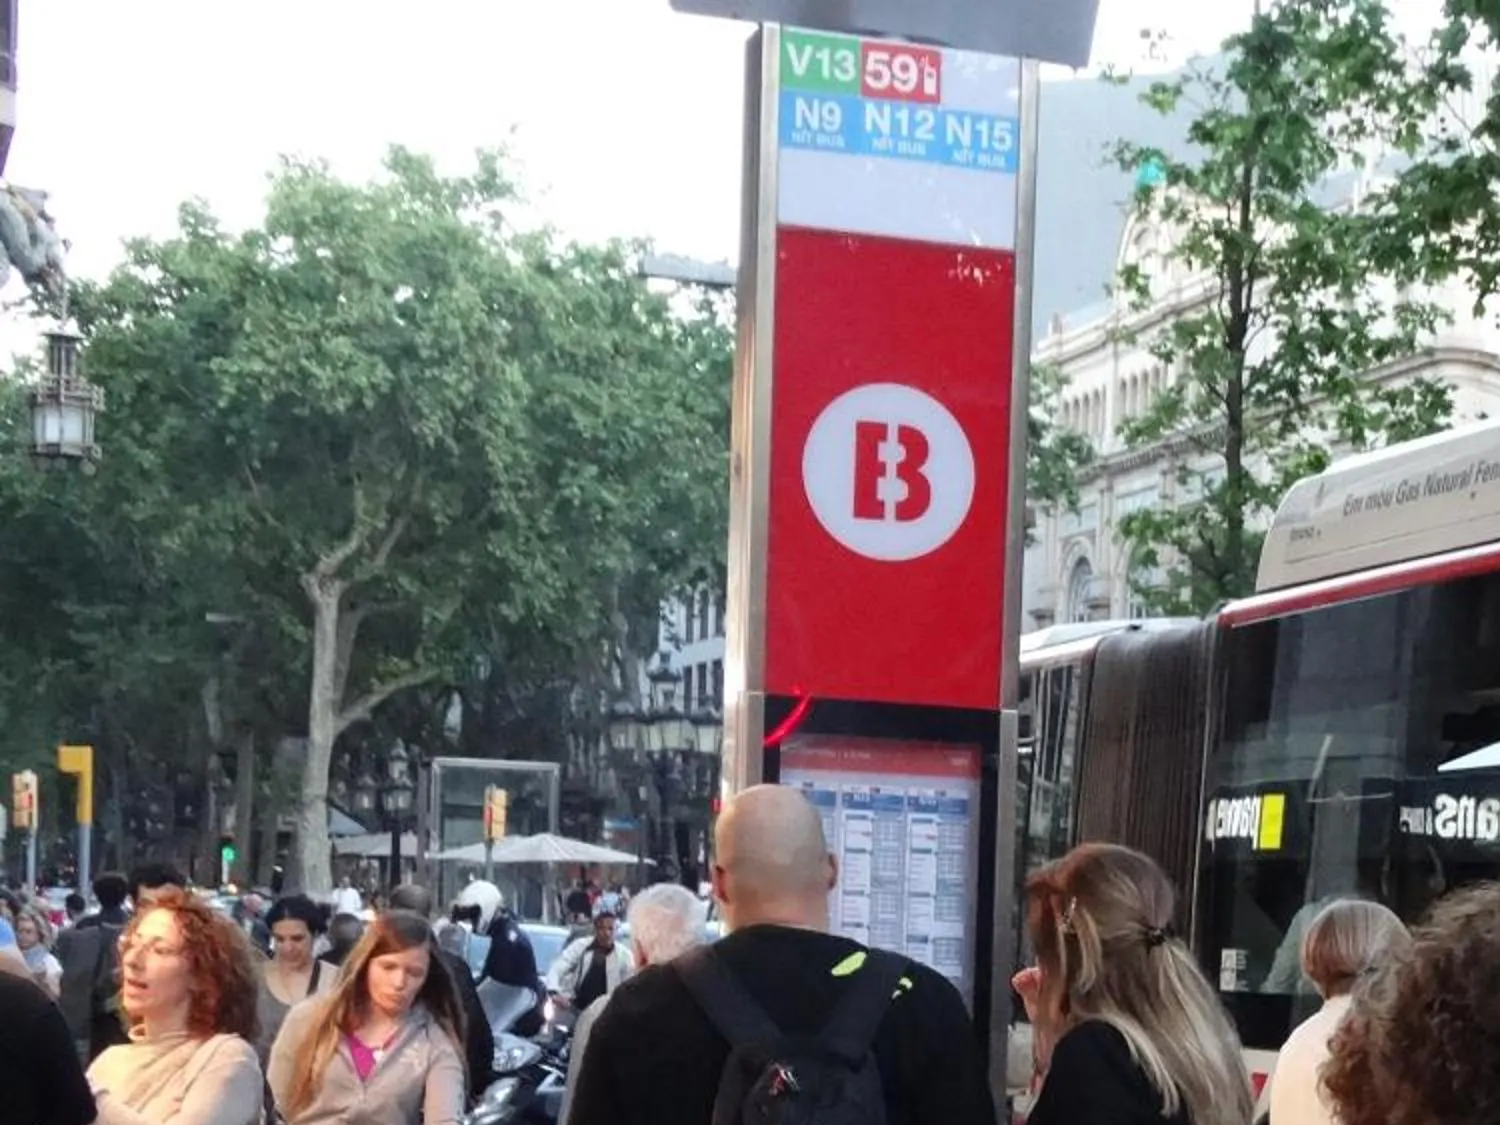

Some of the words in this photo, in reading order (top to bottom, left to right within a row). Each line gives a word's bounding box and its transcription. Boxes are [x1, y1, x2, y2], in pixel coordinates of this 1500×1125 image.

[786, 43, 857, 82] V13
[864, 51, 919, 92] 59
[794, 97, 842, 131] N9
[864, 103, 935, 141] N12
[946, 113, 1012, 151] N15
[853, 420, 932, 522] B
[1396, 479, 1420, 505] Gas
[1424, 464, 1475, 497] Natural
